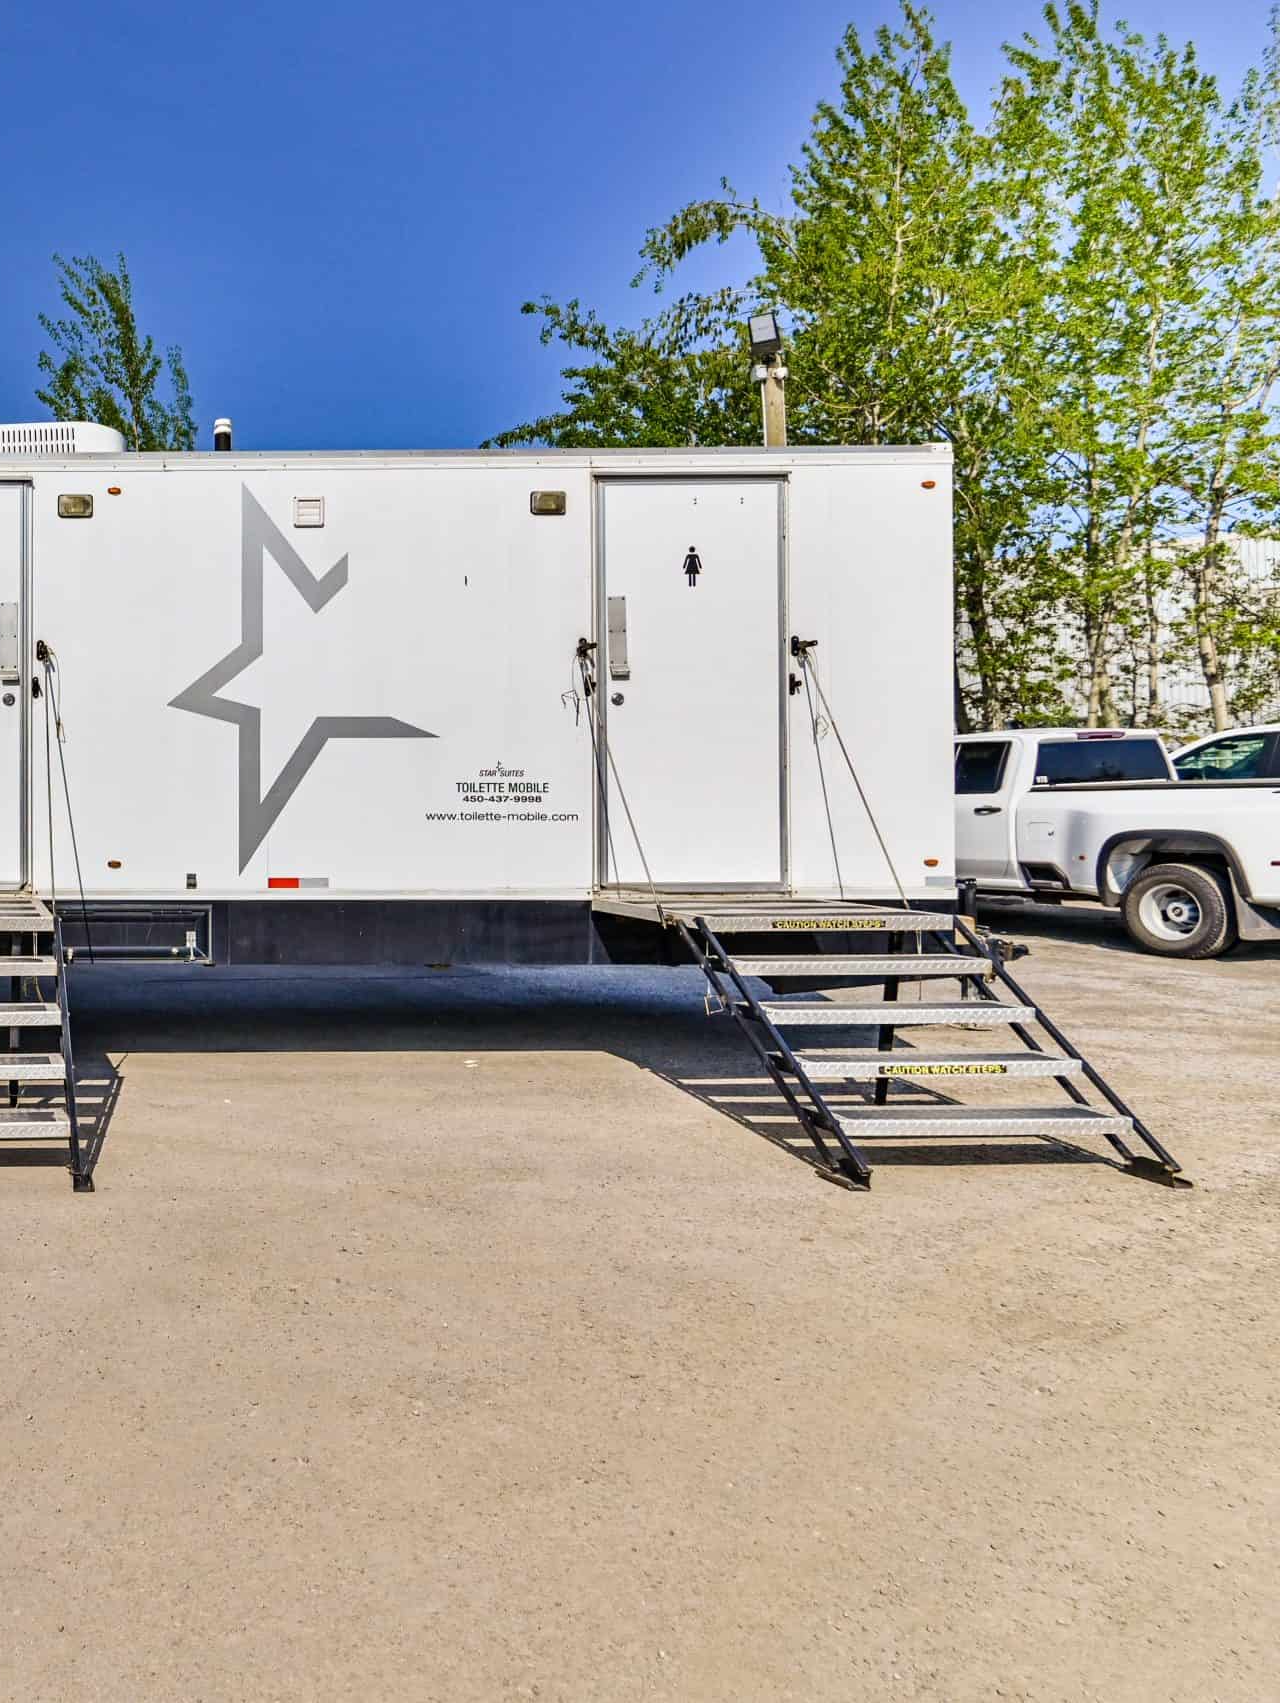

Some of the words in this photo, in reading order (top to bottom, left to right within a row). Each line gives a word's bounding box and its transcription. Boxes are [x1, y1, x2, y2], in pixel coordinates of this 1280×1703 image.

[479, 769, 497, 777] STAR
[499, 769, 525, 777] SUITES
[455, 782, 505, 793] TOILETTE
[508, 782, 549, 793] MOBILE
[425, 811, 579, 822] www.toilette-mobile.com
[776, 920, 818, 929] CAUTION
[884, 1065, 929, 1075] CAUTION
[931, 1065, 966, 1074] WATCH
